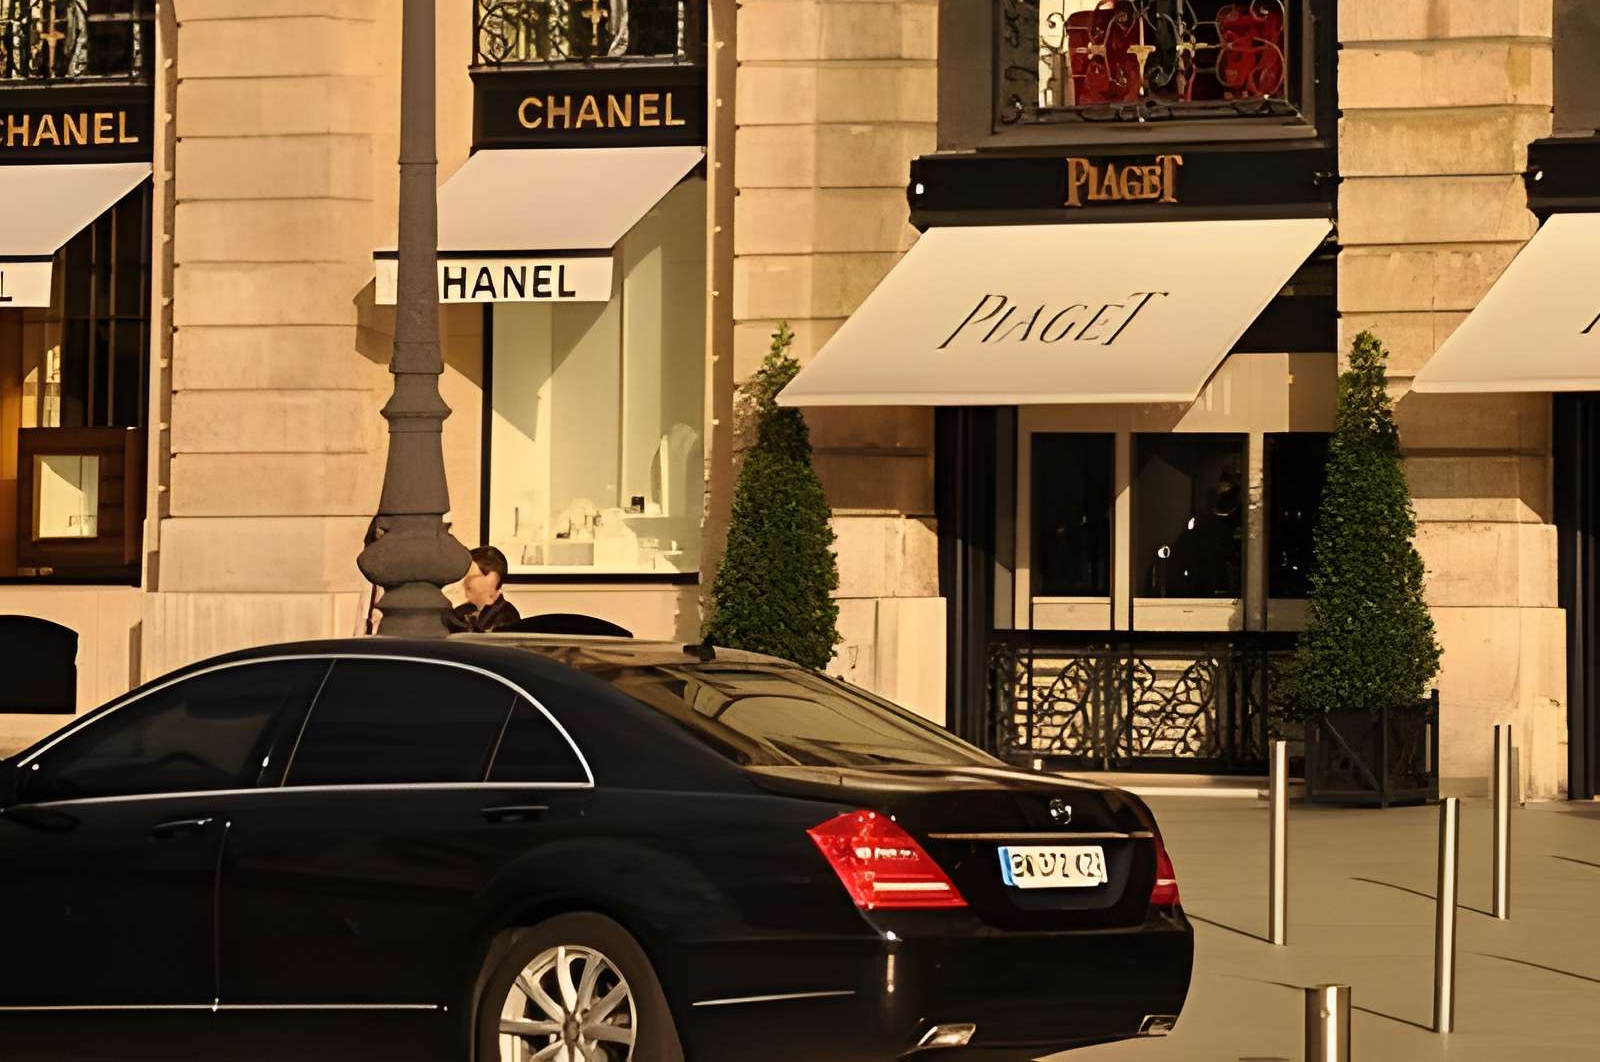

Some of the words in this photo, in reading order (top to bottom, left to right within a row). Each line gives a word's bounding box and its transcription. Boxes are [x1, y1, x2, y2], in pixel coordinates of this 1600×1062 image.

[0, 111, 139, 147] HANEL
[518, 92, 686, 130] CHANEL
[1064, 154, 1183, 207] PIAGET
[443, 264, 576, 300] HANEL
[936, 291, 1169, 350] PIAGET
